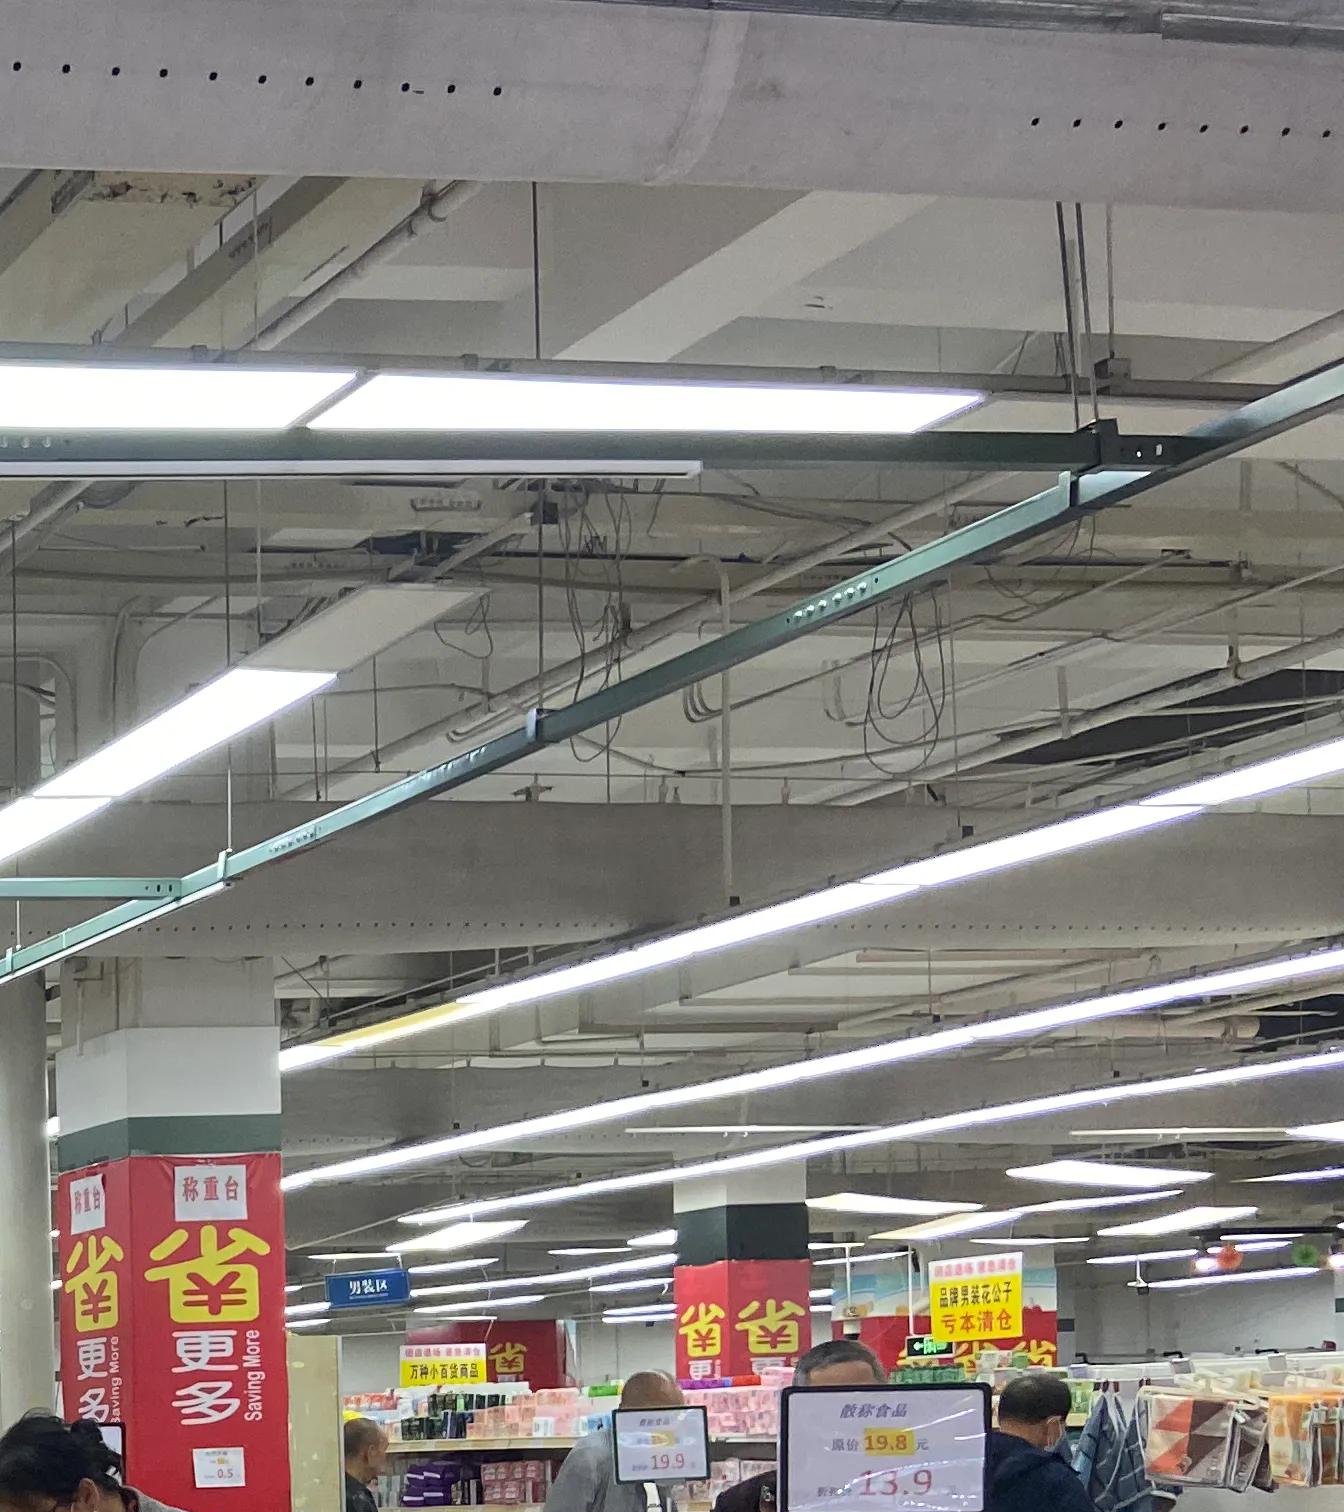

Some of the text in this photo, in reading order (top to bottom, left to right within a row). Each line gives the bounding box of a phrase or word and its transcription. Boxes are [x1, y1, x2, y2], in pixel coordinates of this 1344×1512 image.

[74, 1185, 102, 1216] 称重台
[182, 1175, 239, 1203] 称重台
[349, 1278, 388, 1296] 男装区
[941, 1308, 1012, 1334] 亏本清仓
[110, 1336, 120, 1373] More
[243, 1329, 266, 1422] Saving More
[410, 1364, 479, 1380] 万种小百货商品
[839, 1403, 908, 1419] 散称食品
[865, 1435, 908, 1450] 19.8
[916, 1438, 929, 1451] 元
[651, 1453, 685, 1470] 19.9
[859, 1469, 932, 1496] 13.9
